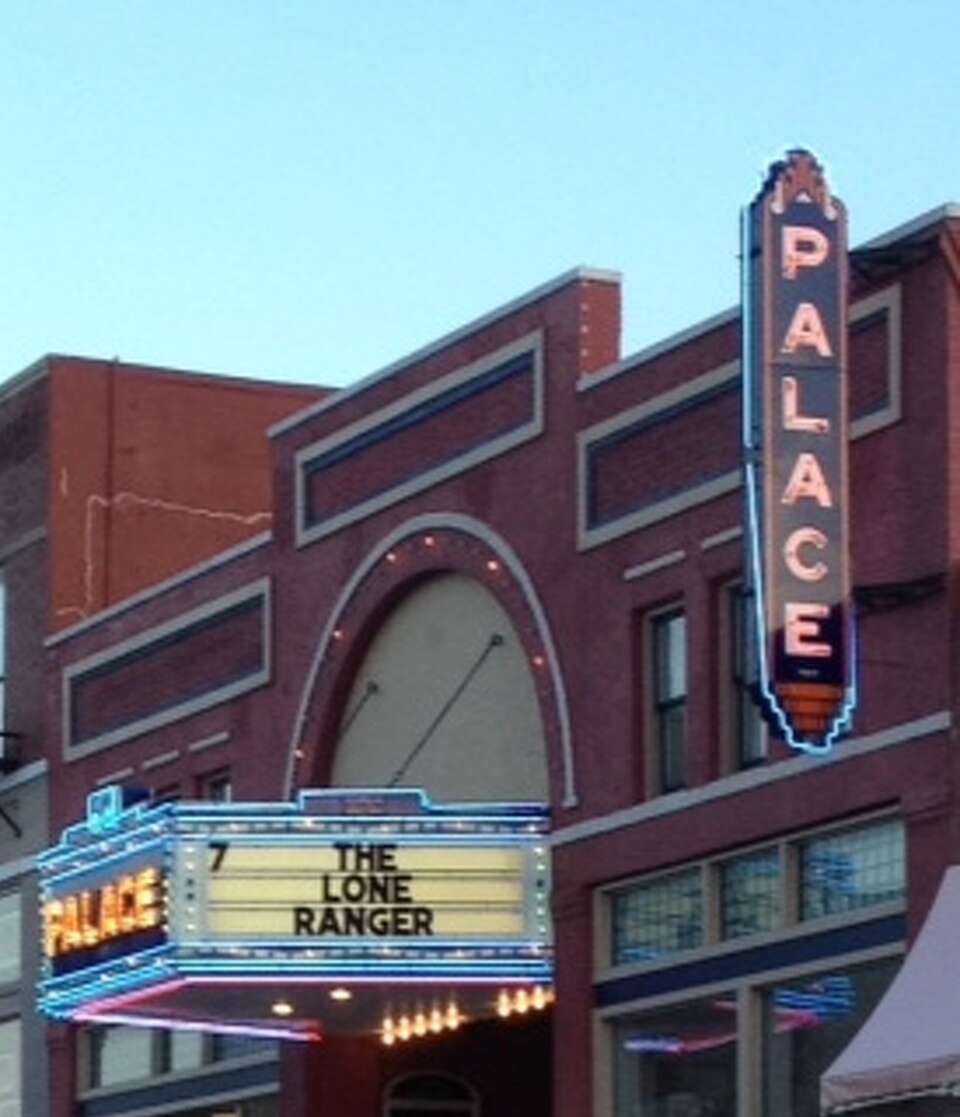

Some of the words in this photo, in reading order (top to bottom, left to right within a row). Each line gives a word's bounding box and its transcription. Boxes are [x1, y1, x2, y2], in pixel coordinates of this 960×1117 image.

[781, 226, 833, 657] PALACE
[208, 843, 229, 872] 7
[333, 843, 398, 872] THE
[322, 875, 414, 904] LONE
[44, 865, 156, 957] PALACE
[294, 907, 435, 937] RANGER
